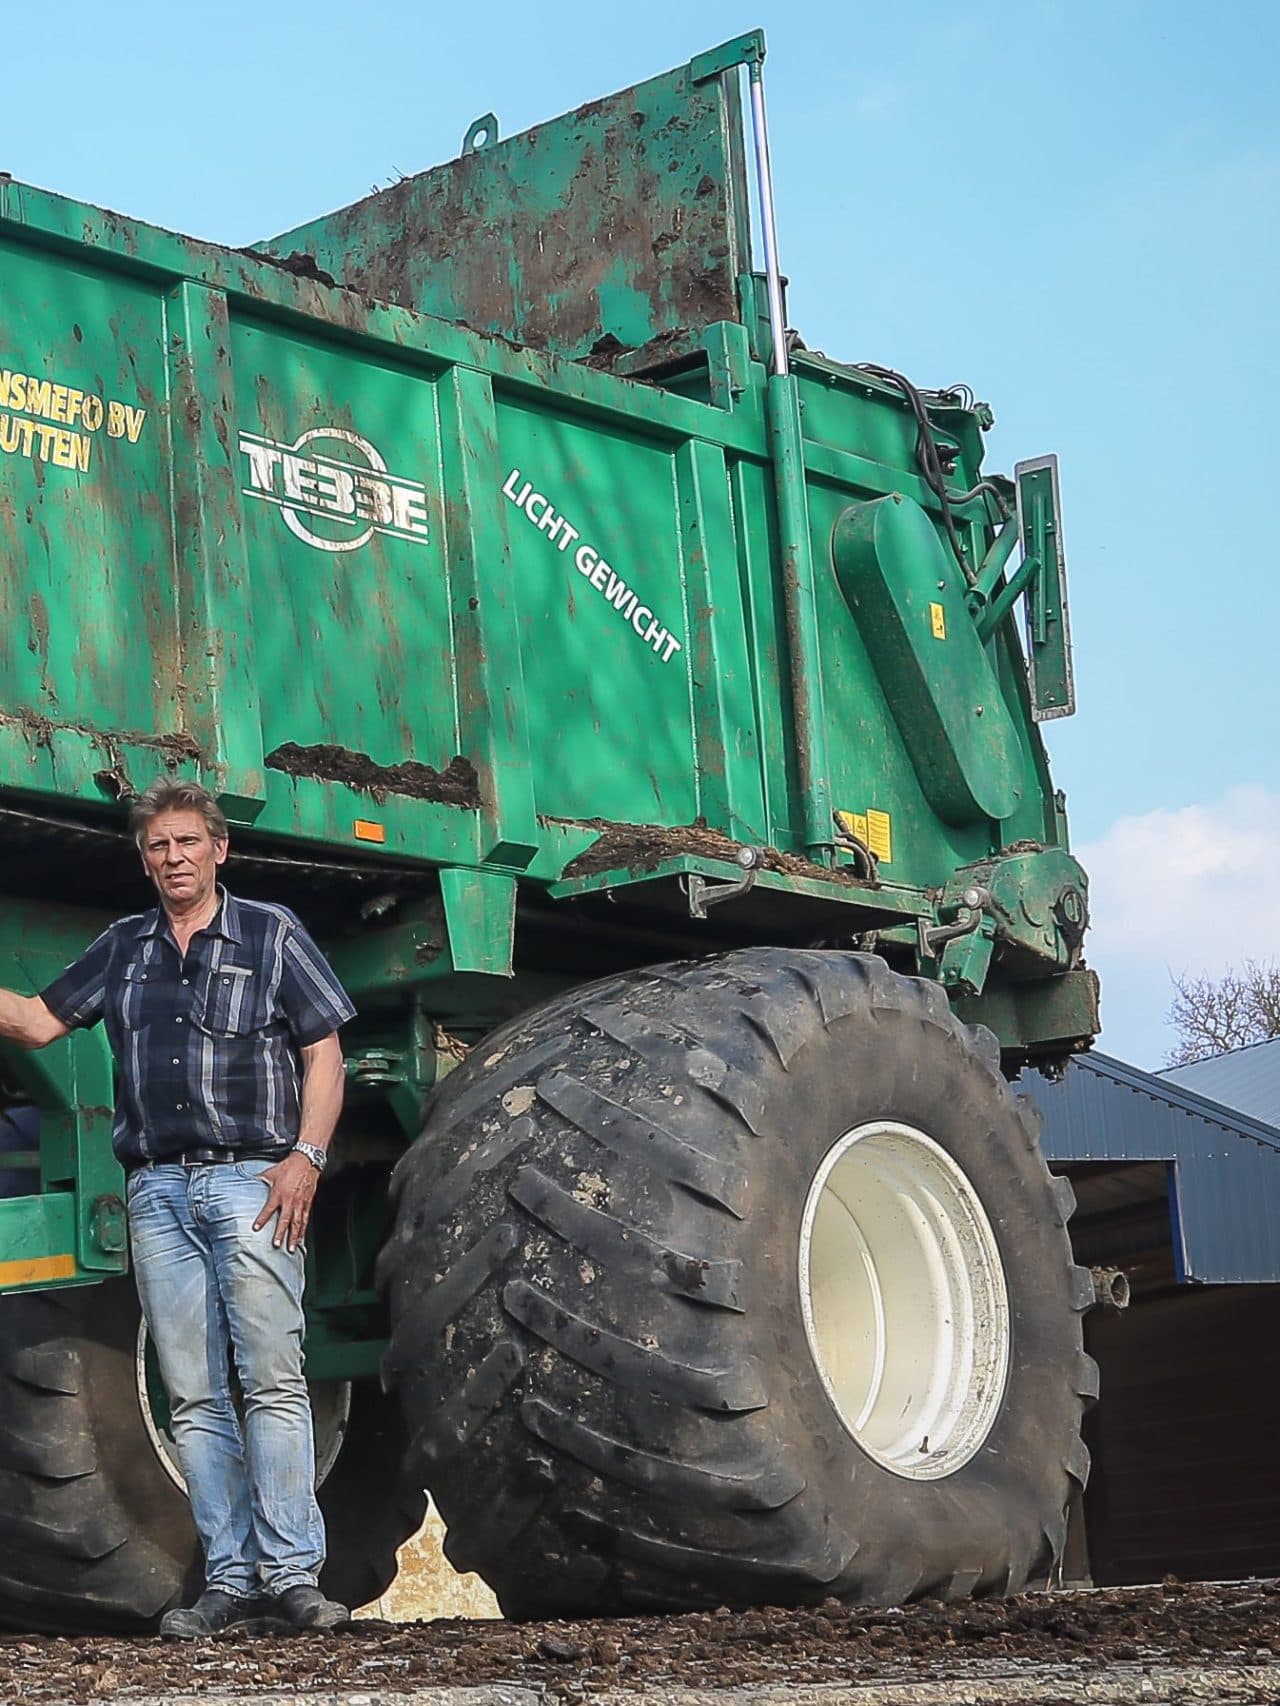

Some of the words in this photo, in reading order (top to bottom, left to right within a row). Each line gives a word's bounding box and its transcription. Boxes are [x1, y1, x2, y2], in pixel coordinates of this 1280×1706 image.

[108, 401, 146, 444] BV
[239, 440, 429, 535] TEBBE
[502, 469, 579, 551] LICHT
[575, 545, 681, 663] GEWICHT
